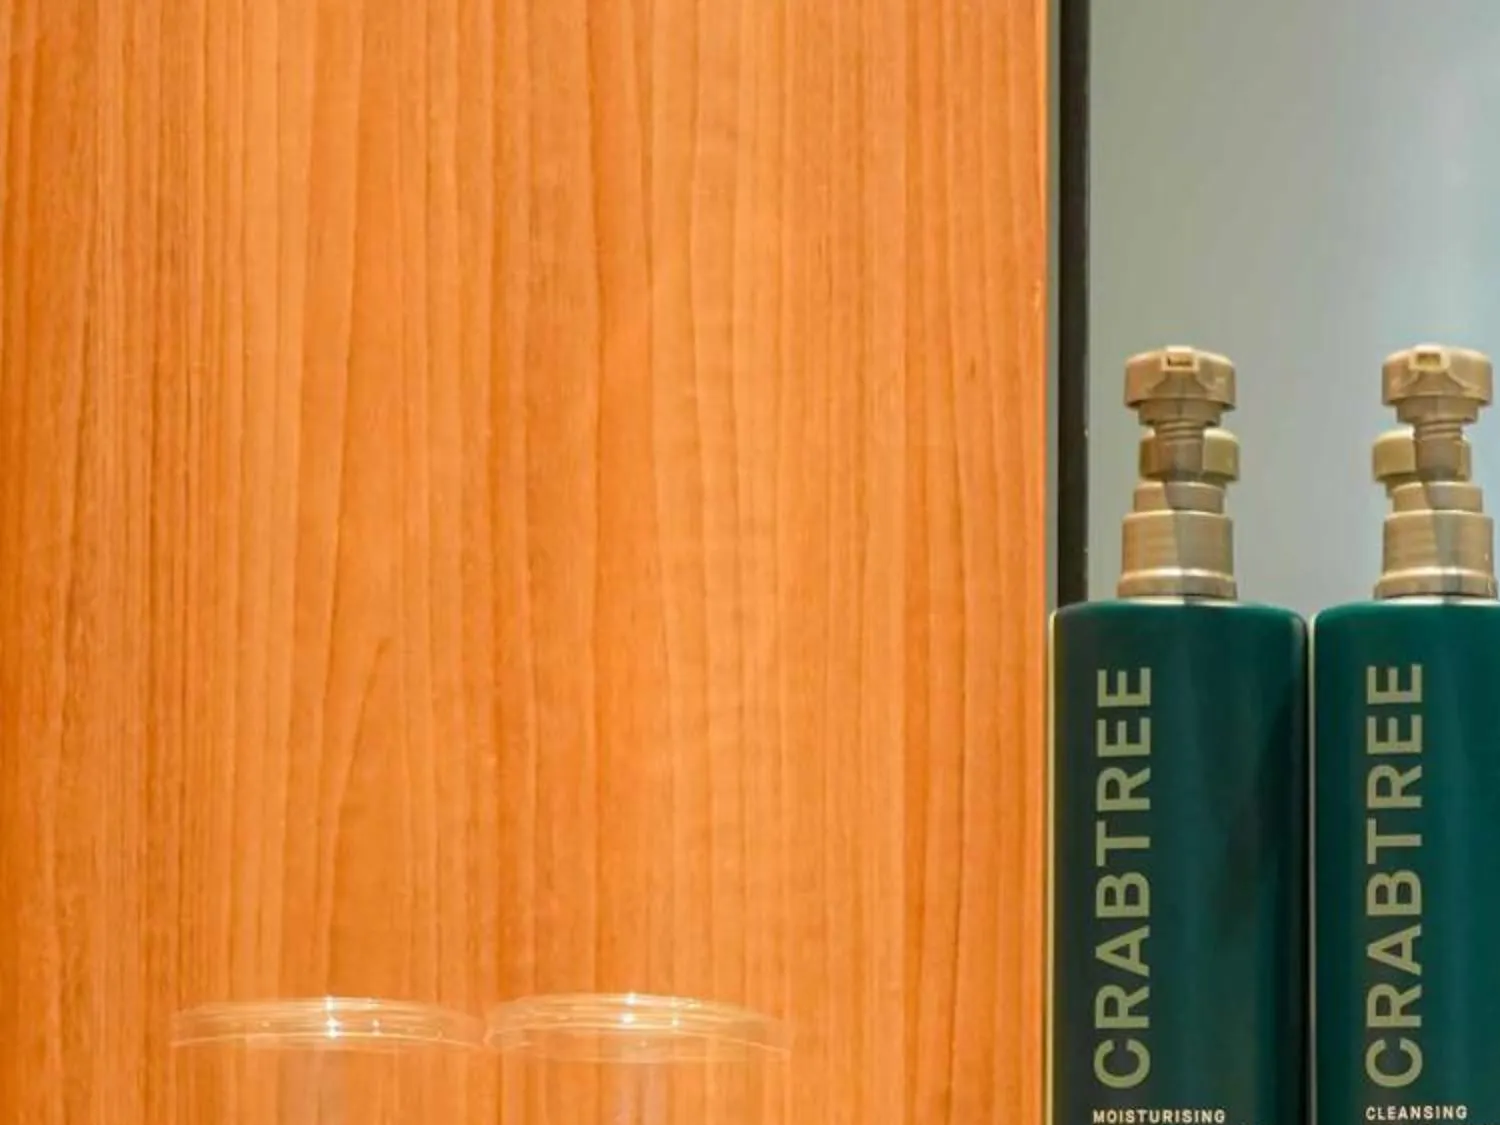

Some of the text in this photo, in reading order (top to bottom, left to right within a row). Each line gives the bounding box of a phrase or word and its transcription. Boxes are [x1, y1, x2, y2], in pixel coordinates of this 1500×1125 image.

[1093, 667, 1152, 1089] CRABTREE
[1365, 663, 1423, 1088] CRABTREE
[1093, 1109, 1226, 1124] MOISTURISING
[1365, 1104, 1468, 1121] CLEANSING
